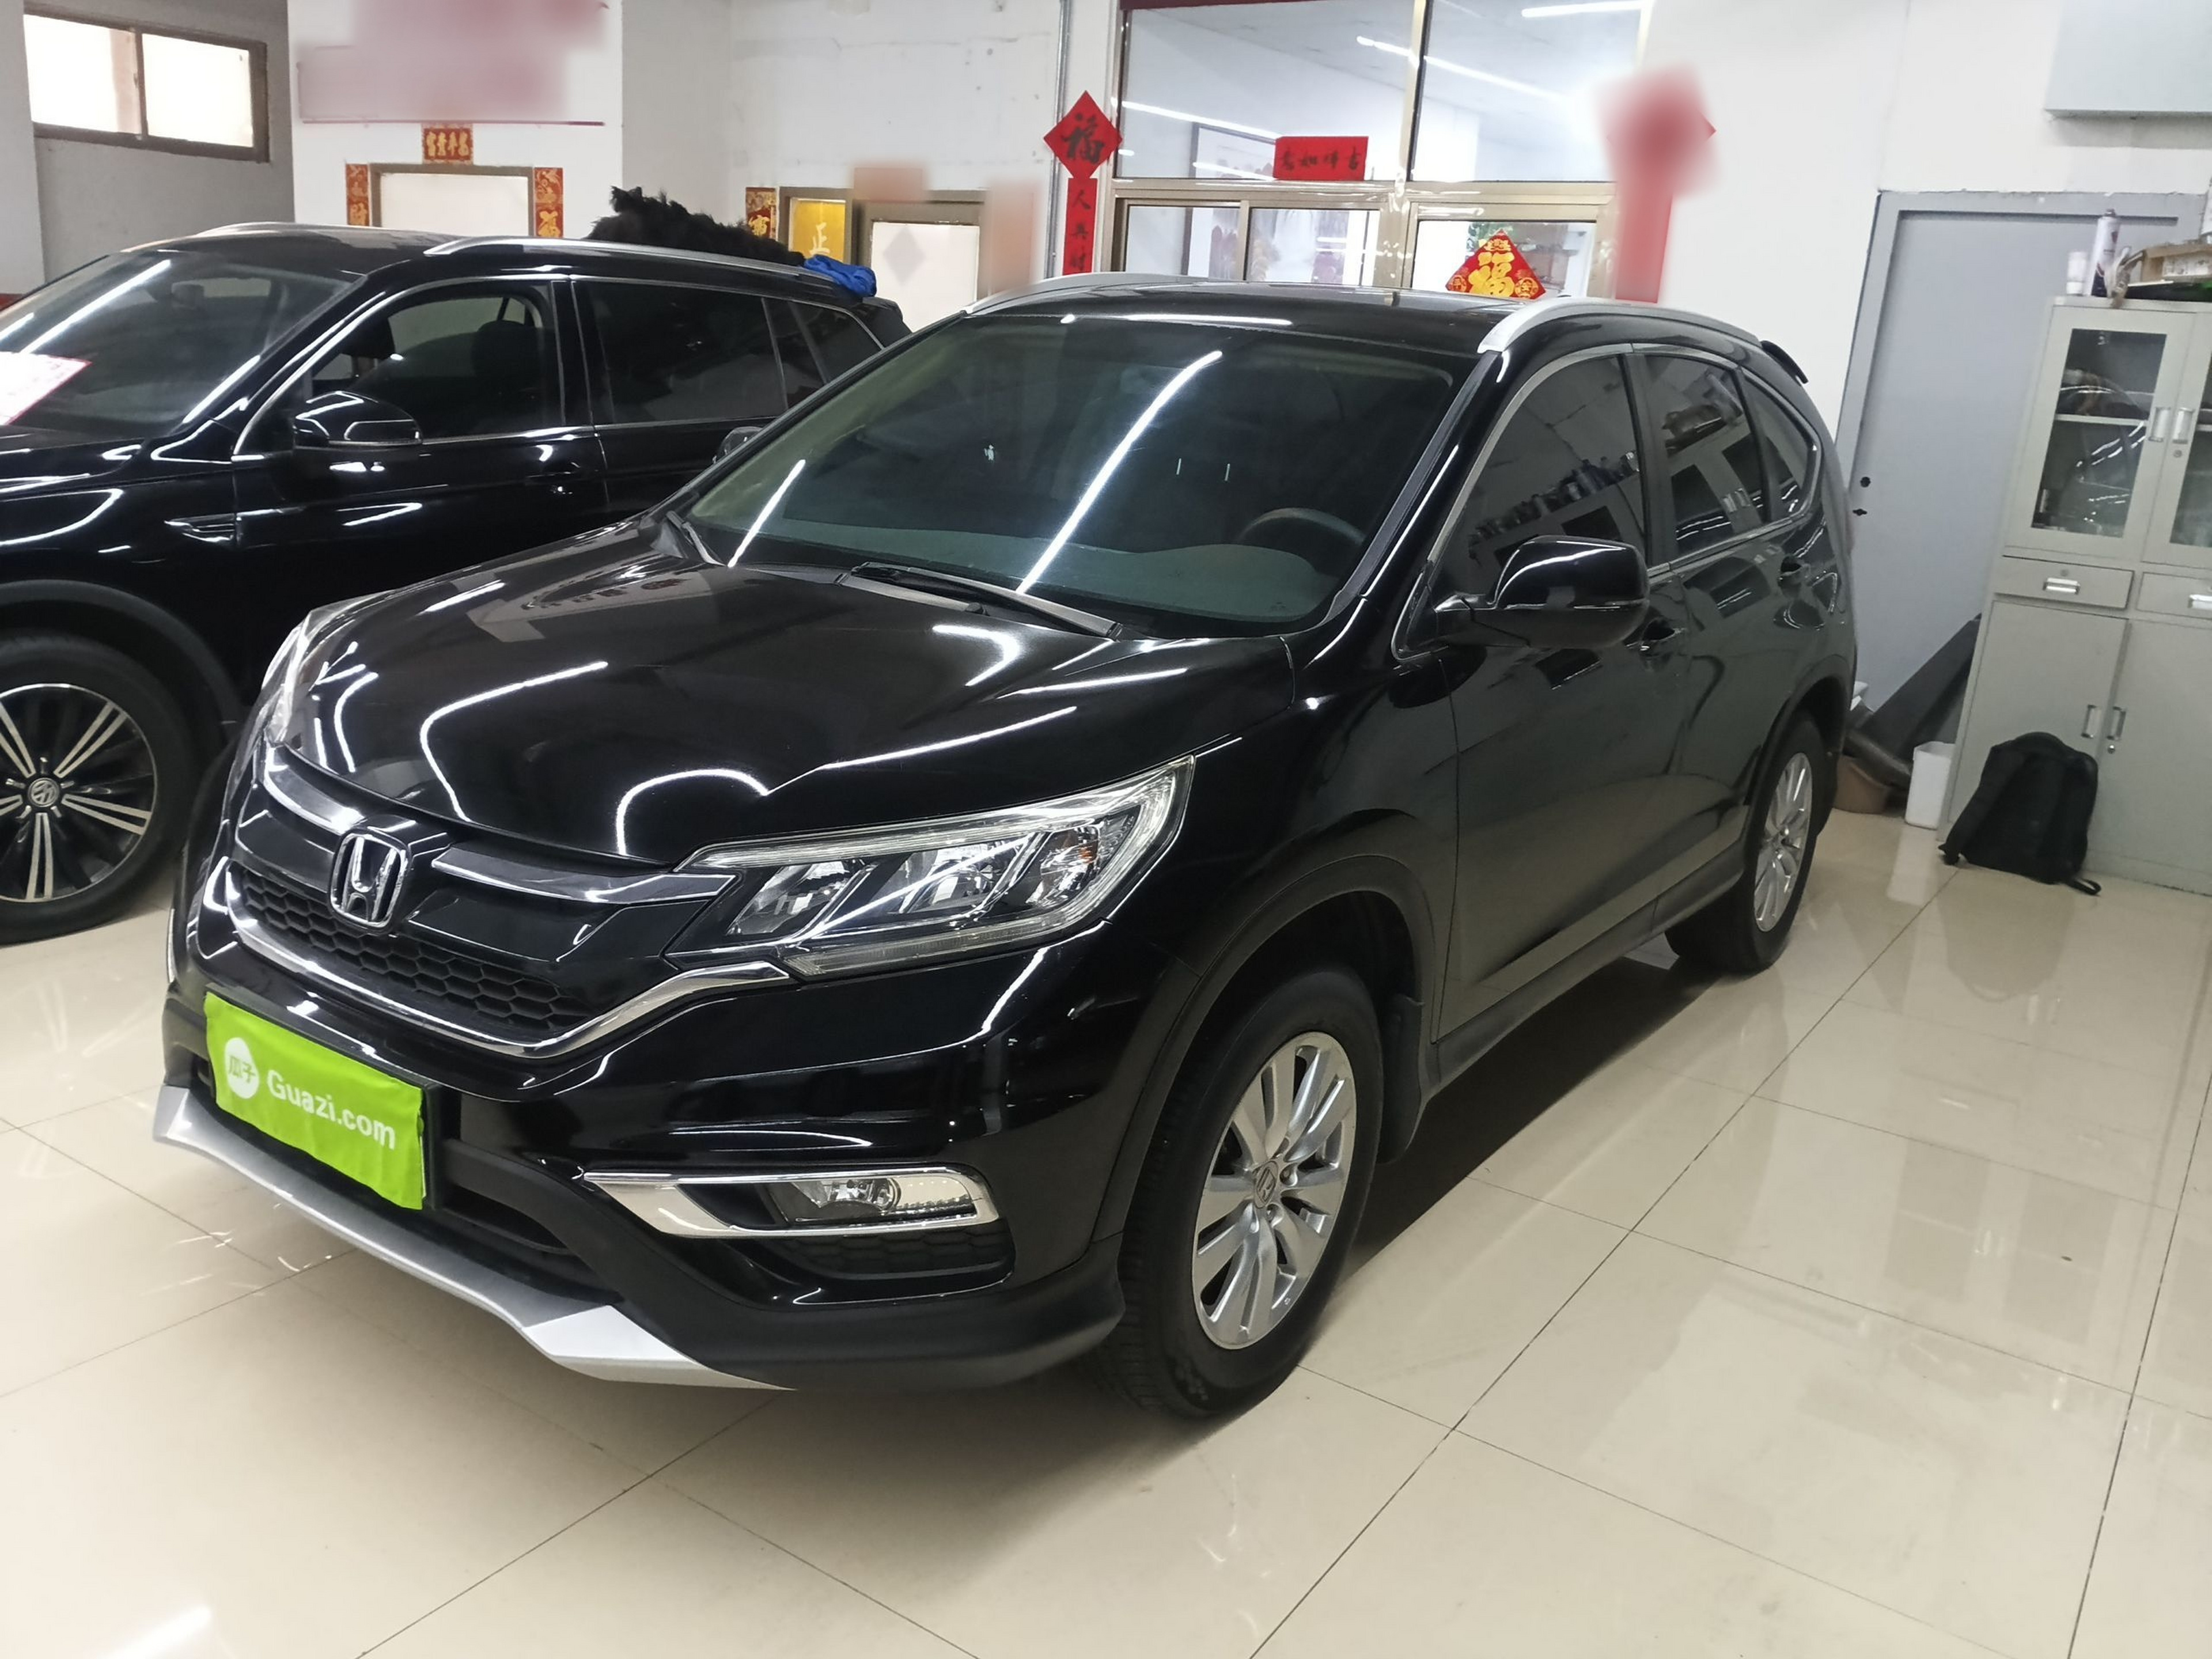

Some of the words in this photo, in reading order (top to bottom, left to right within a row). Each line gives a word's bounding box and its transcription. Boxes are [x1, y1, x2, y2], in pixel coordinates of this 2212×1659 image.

[1060, 112, 1105, 164] 福
[1469, 251, 1515, 298] 福
[228, 1054, 257, 1084] 瓜子
[266, 1069, 397, 1150] Guazi.com
